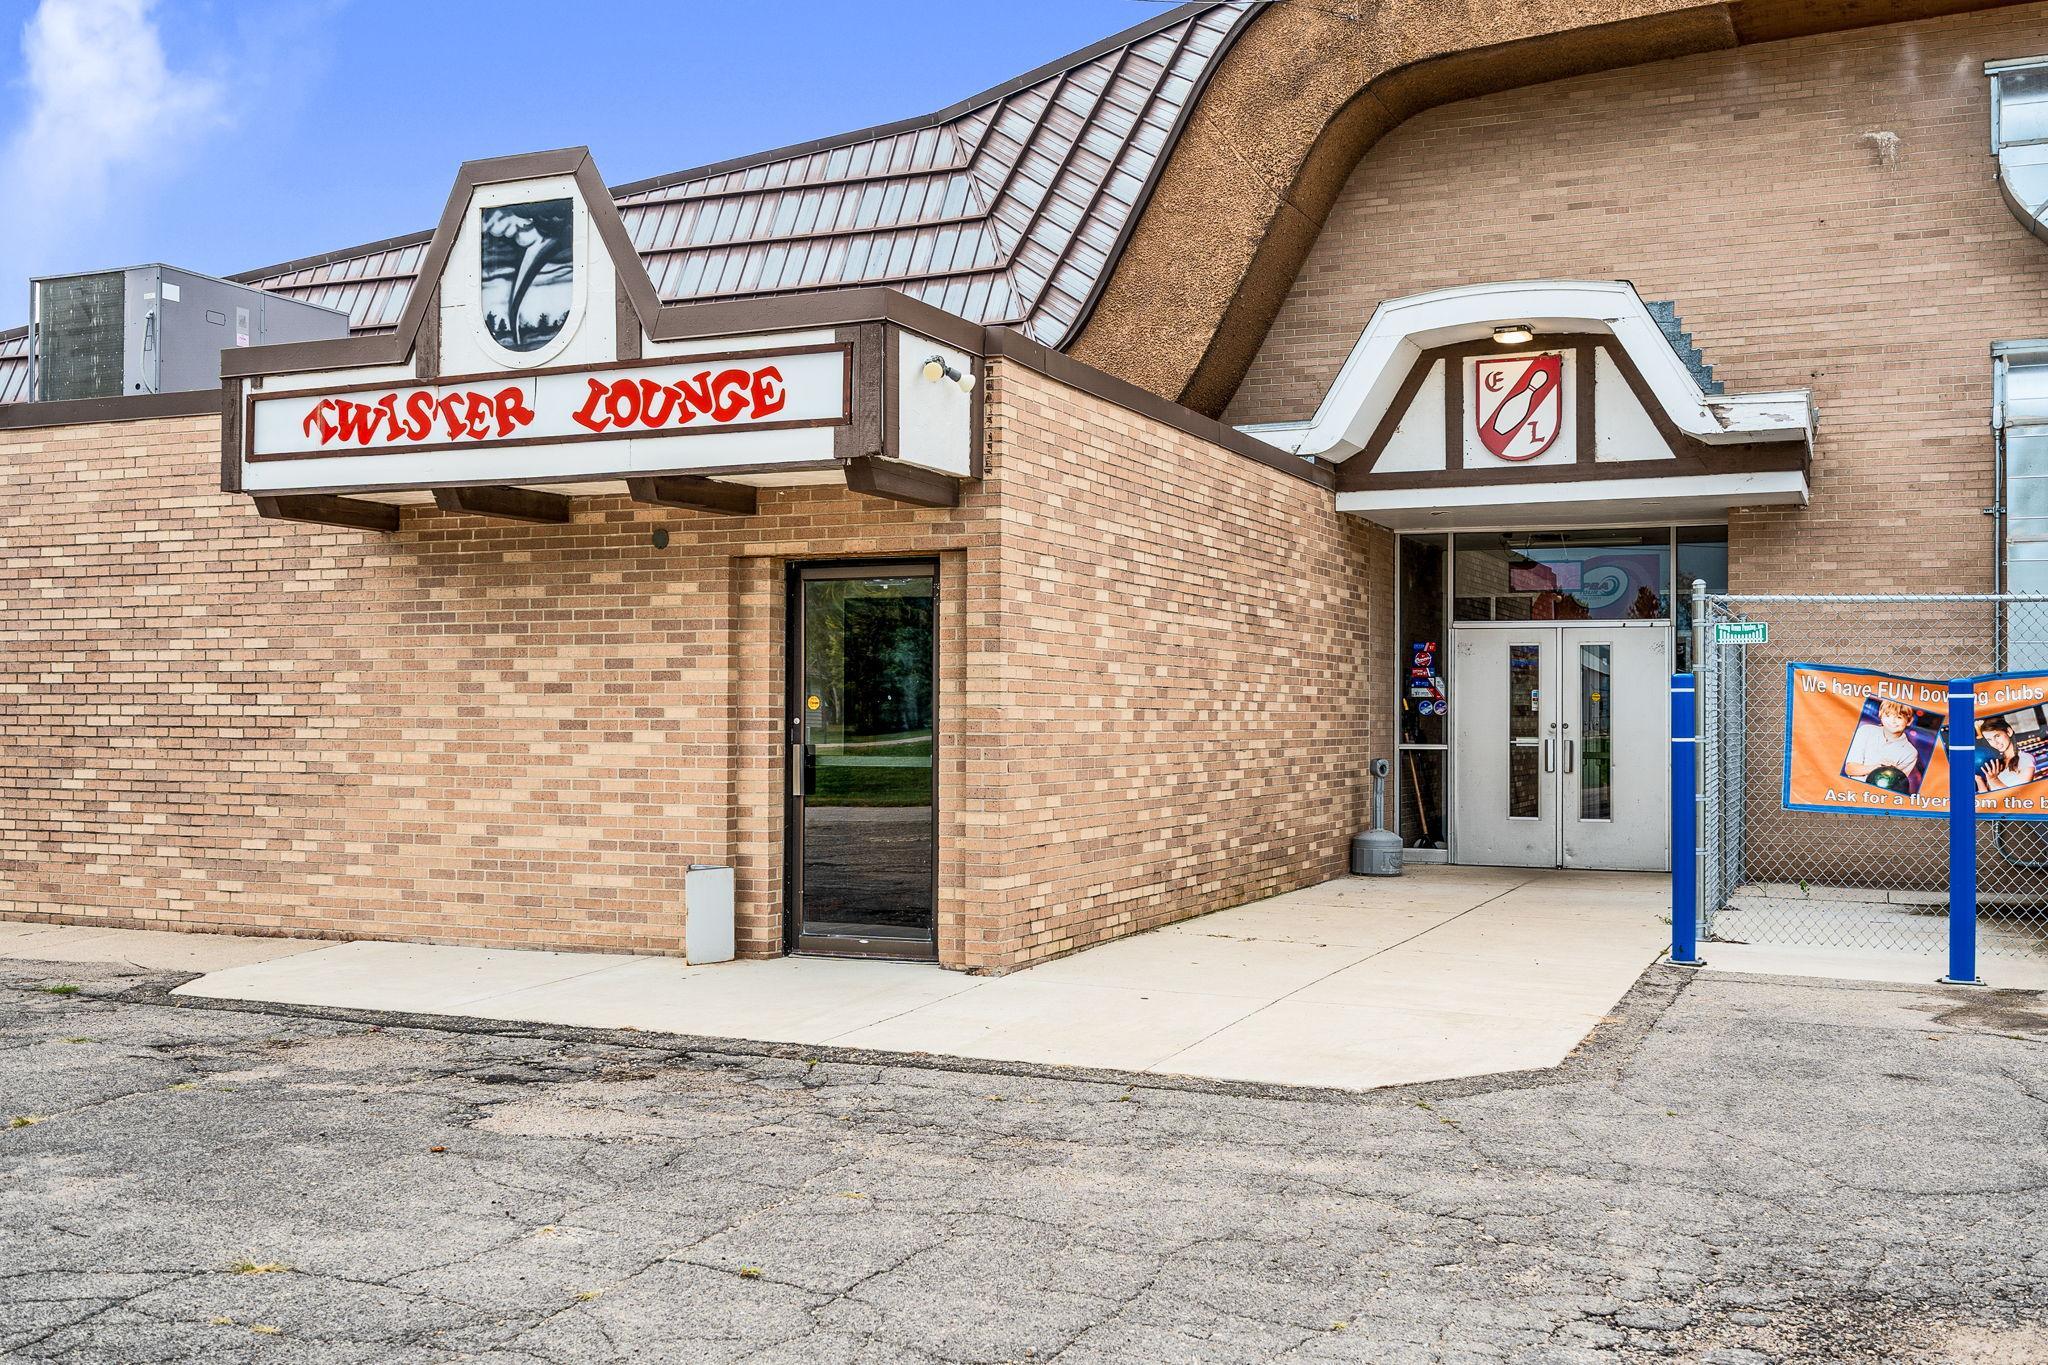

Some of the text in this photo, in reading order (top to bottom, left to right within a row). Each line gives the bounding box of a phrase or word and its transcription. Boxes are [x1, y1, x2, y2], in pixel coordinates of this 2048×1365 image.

[303, 365, 785, 445] TWISTER LOUNGE
[1801, 675, 1826, 693] We
[1832, 678, 1871, 697] have
[1877, 681, 1914, 700] FUN
[1994, 684, 2044, 702] clubs
[1824, 789, 1857, 802] Ask
[1863, 791, 1888, 804] for
[1893, 795, 1904, 805] a
[1909, 793, 1950, 808] flyer
[2004, 797, 2034, 808] the
